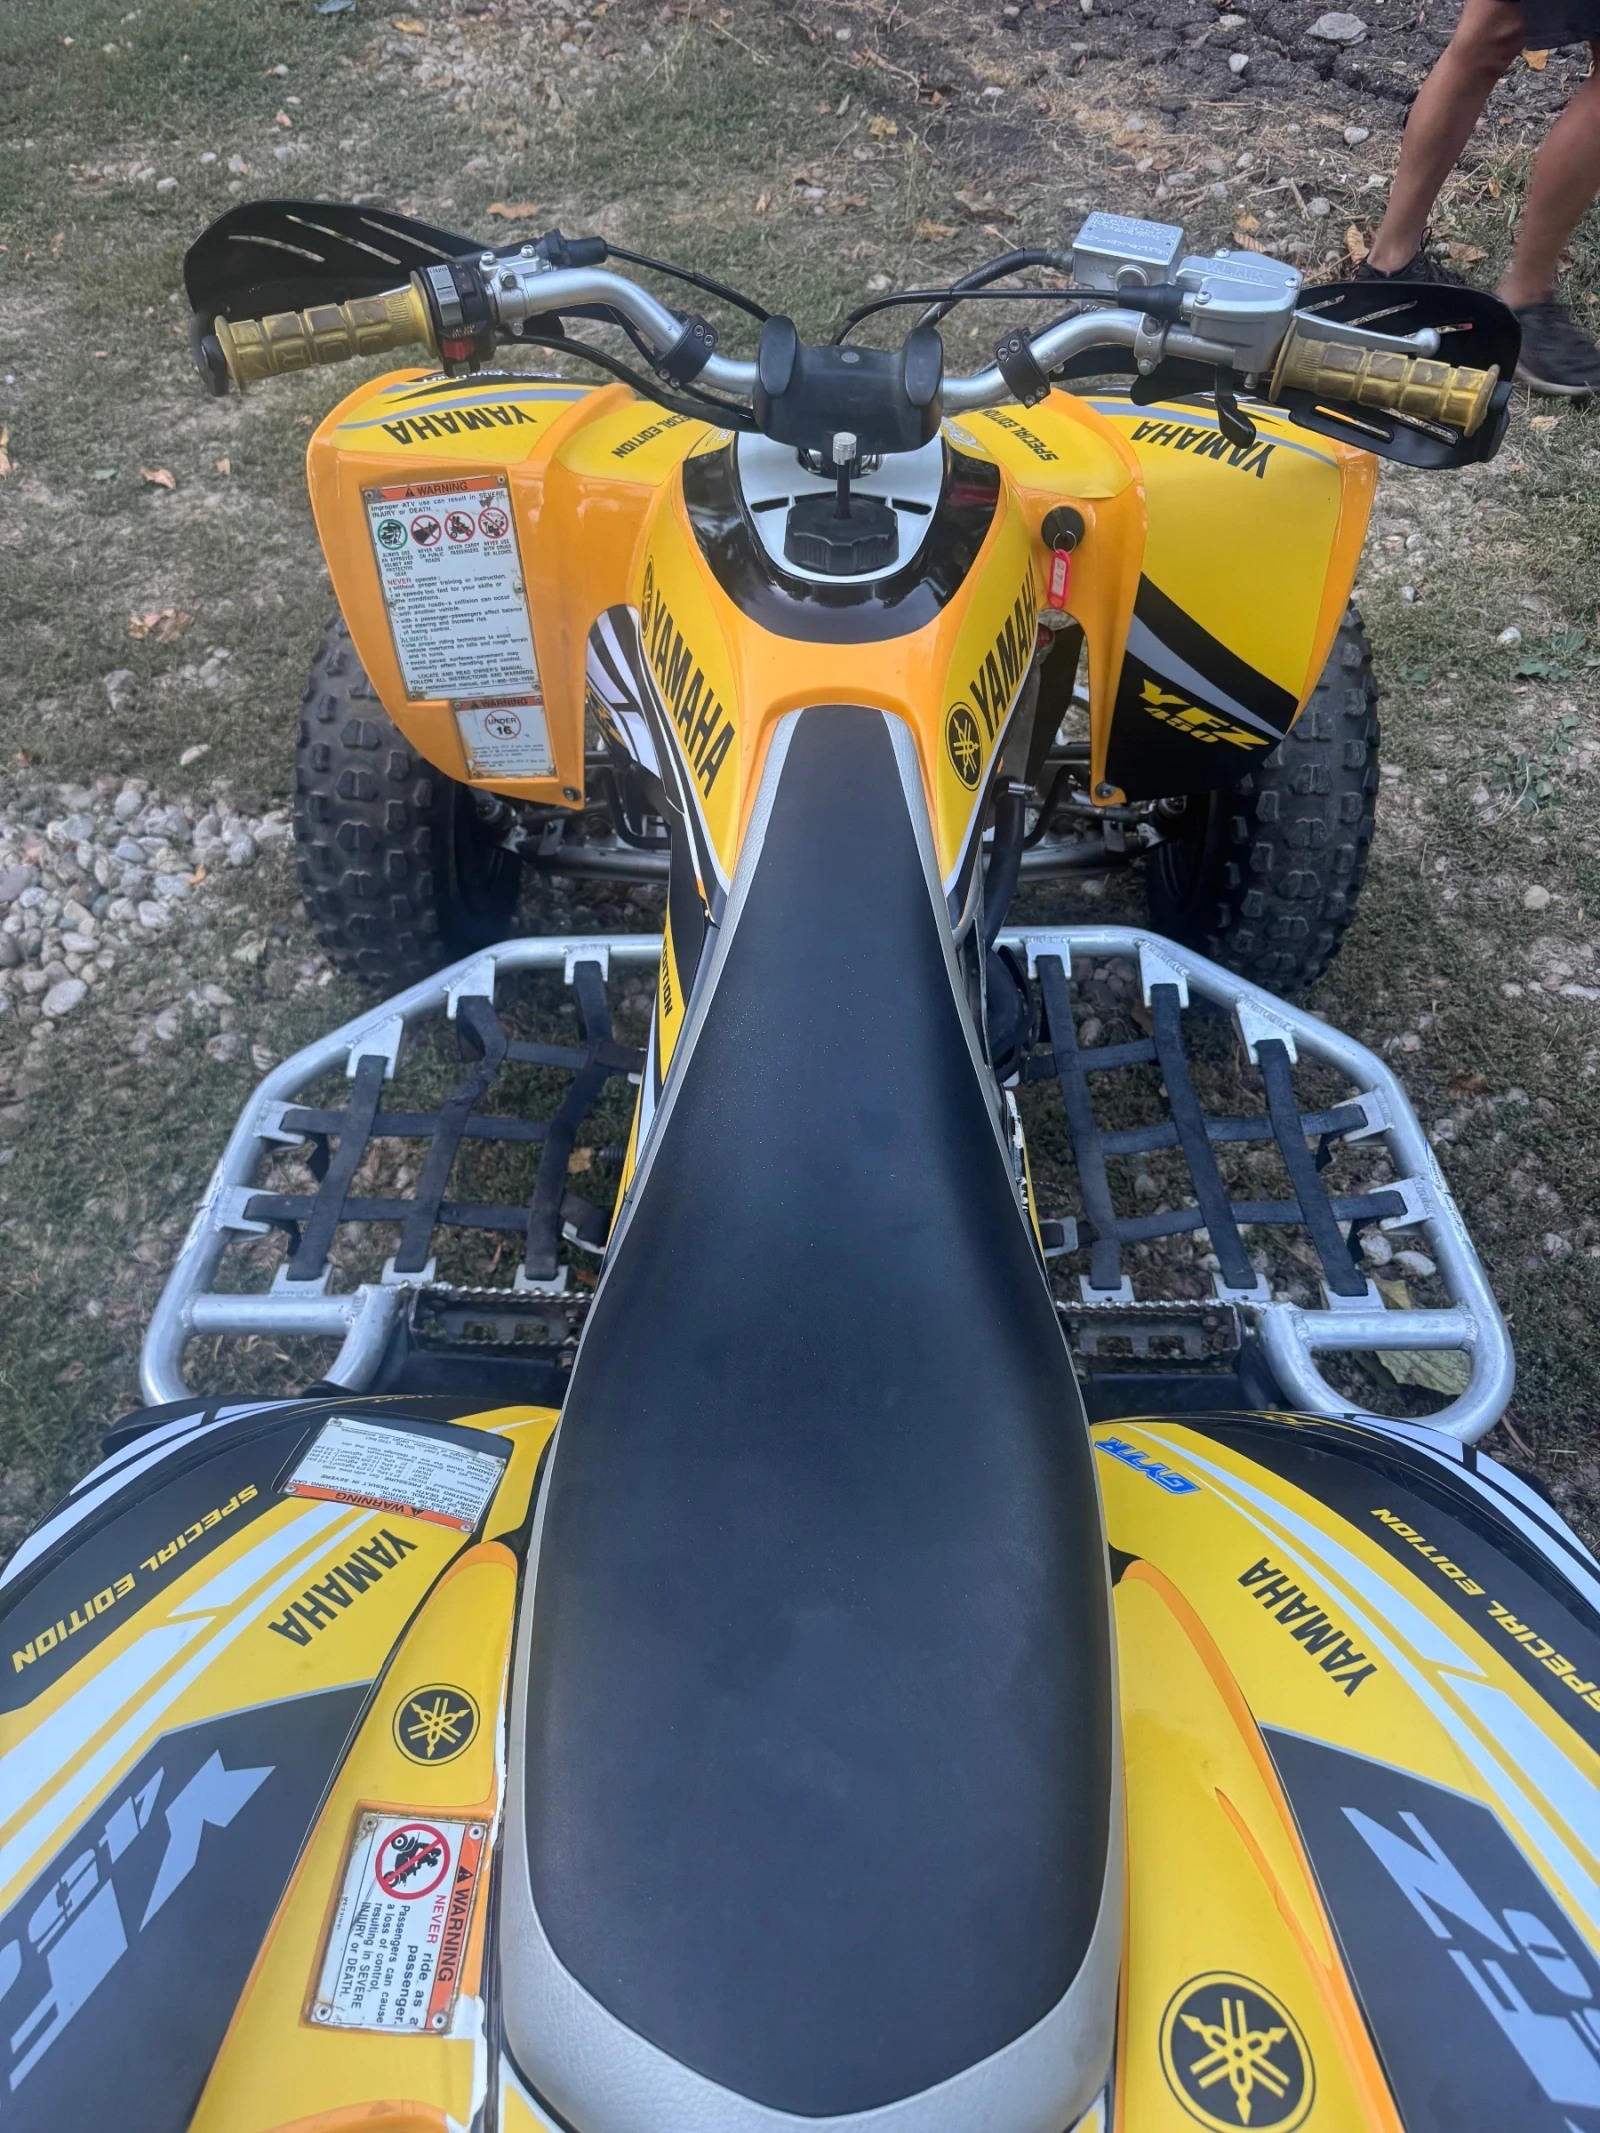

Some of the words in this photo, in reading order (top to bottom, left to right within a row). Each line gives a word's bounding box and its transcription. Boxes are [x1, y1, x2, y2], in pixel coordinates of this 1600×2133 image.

[381, 405, 538, 445] YAMAHA
[656, 411, 692, 429] ECIAL
[979, 409, 1019, 431] EDITION
[611, 421, 664, 459] EDITION
[1013, 427, 1059, 462] SPECIAL
[1130, 421, 1276, 479] YAMAHA
[416, 482, 468, 495] WARNING
[478, 490, 504, 498] SEVERE
[387, 577, 411, 585] NEVER
[969, 555, 1037, 743] YAMAHA
[480, 697, 528, 709] WARNING
[650, 588, 735, 800] YAMAHA
[496, 725, 512, 734] 16
[1139, 678, 1269, 750] YFZ
[1144, 707, 1219, 743] 450
[320, 1473, 349, 1483] SEVERE
[1094, 1436, 1202, 1494] GYTR
[309, 1479, 361, 1495] OVERLOADING
[334, 1490, 406, 1513] WARNING
[361, 1481, 389, 1490] RESULT
[379, 1489, 415, 1500] CONTROL
[409, 1491, 445, 1503] CONTROL
[441, 1490, 483, 1505] OPERATING
[139, 1483, 259, 1572] SPECIAL
[1370, 1508, 1487, 1596] EDITION
[267, 1529, 419, 1647] YAMAHA
[11, 1572, 136, 1674] EDITION
[1237, 1556, 1378, 1698] YAMAHA
[9, 1749, 276, 2093] YF
[352, 1901, 371, 1938] INJURY
[362, 1902, 383, 1946] resulting
[380, 1912, 395, 1934] loss
[386, 1904, 411, 1962] Passengers
[426, 1894, 447, 1944] NEVER
[437, 1886, 470, 1982] WARNING
[348, 1942, 359, 1953] or
[361, 1950, 373, 1959] in
[377, 1938, 389, 1949] of
[338, 1957, 358, 1997] DEATH.
[366, 1952, 386, 1992] control,
[382, 1967, 395, 1986] can
[417, 1952, 434, 1981] ride
[1340, 1806, 1600, 2133] FZ
[350, 1963, 370, 2009] SEVERE
[391, 1944, 419, 2025] passenger.
[411, 1990, 425, 2007] as
[375, 1991, 389, 2023] cause
[408, 2017, 419, 2025] a
